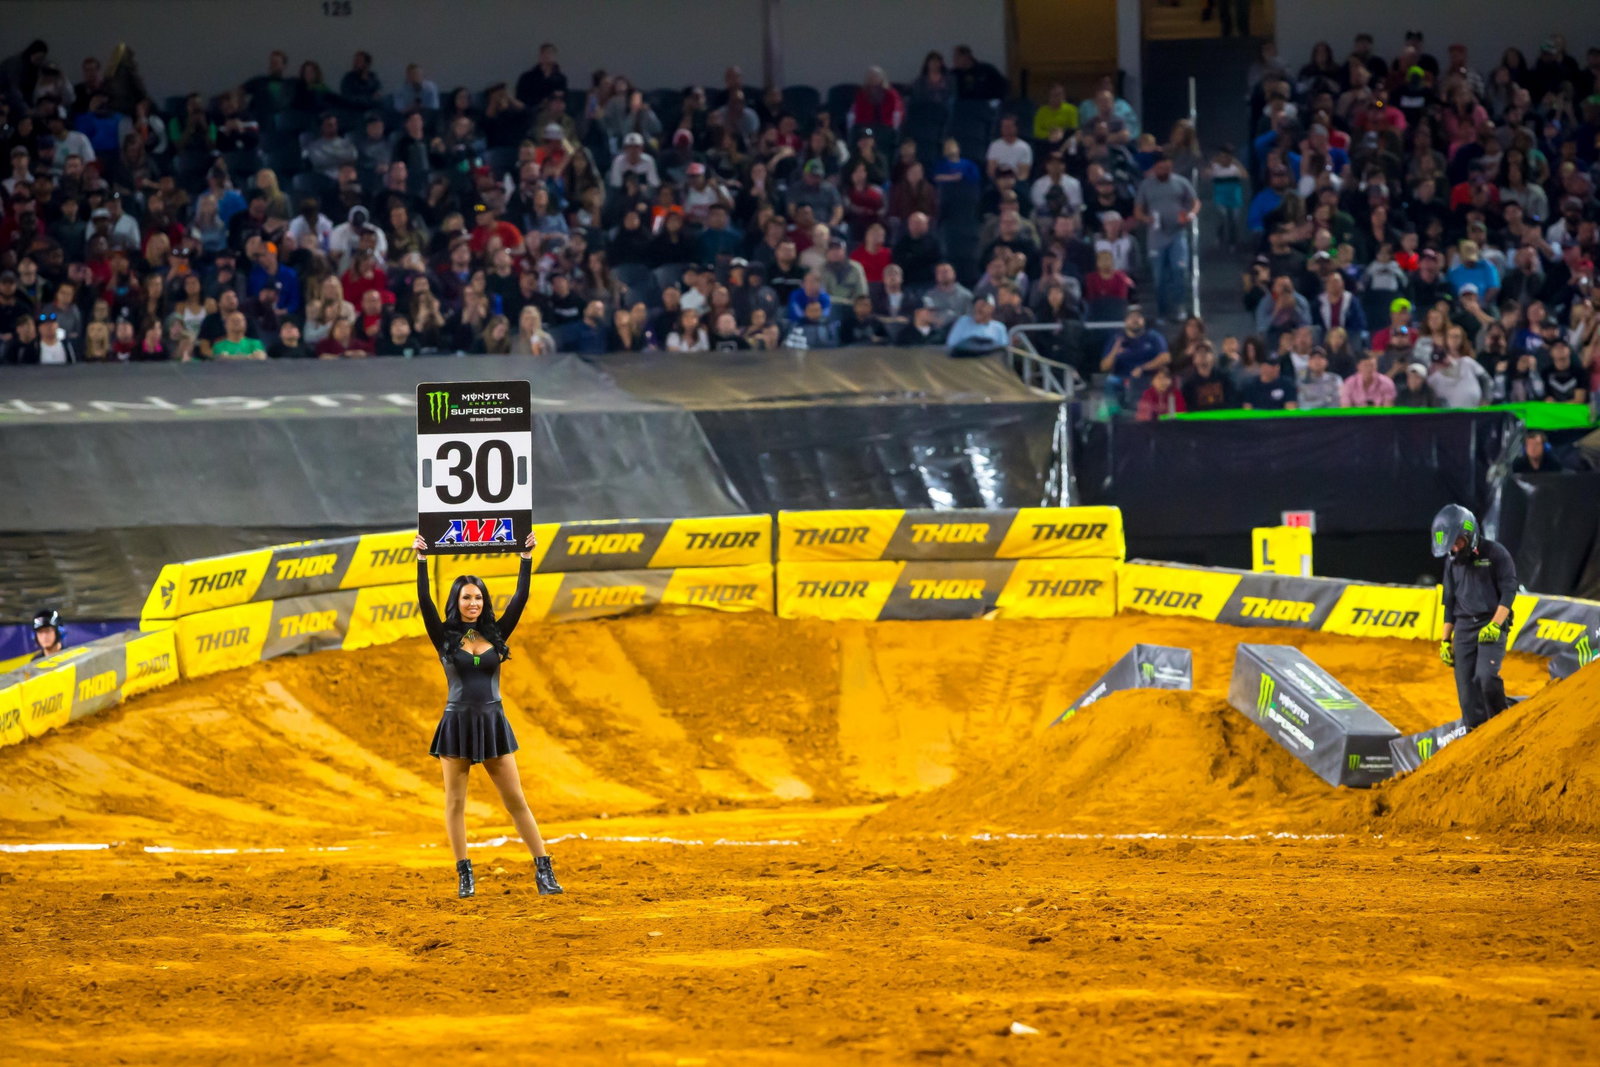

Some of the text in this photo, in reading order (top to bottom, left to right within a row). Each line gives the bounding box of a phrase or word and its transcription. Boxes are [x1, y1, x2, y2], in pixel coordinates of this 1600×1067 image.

[450, 407, 523, 416] SUPERCROSS
[435, 439, 515, 505] 30
[435, 518, 517, 544] AMA
[686, 531, 761, 550] THOR
[793, 526, 870, 545] THOR
[910, 523, 990, 543] THOR
[1032, 523, 1108, 540] THOR
[567, 532, 645, 556] THOR
[275, 553, 338, 581] THOR
[188, 569, 247, 596] THOR
[686, 584, 758, 602] THOR
[797, 580, 870, 598] THOR
[909, 579, 986, 600] THOR
[1027, 579, 1104, 597] THOR
[571, 585, 647, 608] THOR
[1133, 587, 1203, 610] THOR
[1240, 596, 1316, 623] THOR
[1351, 607, 1421, 628] THOR
[279, 609, 338, 638] THOR
[1535, 618, 1587, 643] THO
[196, 627, 250, 653] THOR
[78, 670, 117, 702] THOR
[31, 693, 64, 720] THOR
